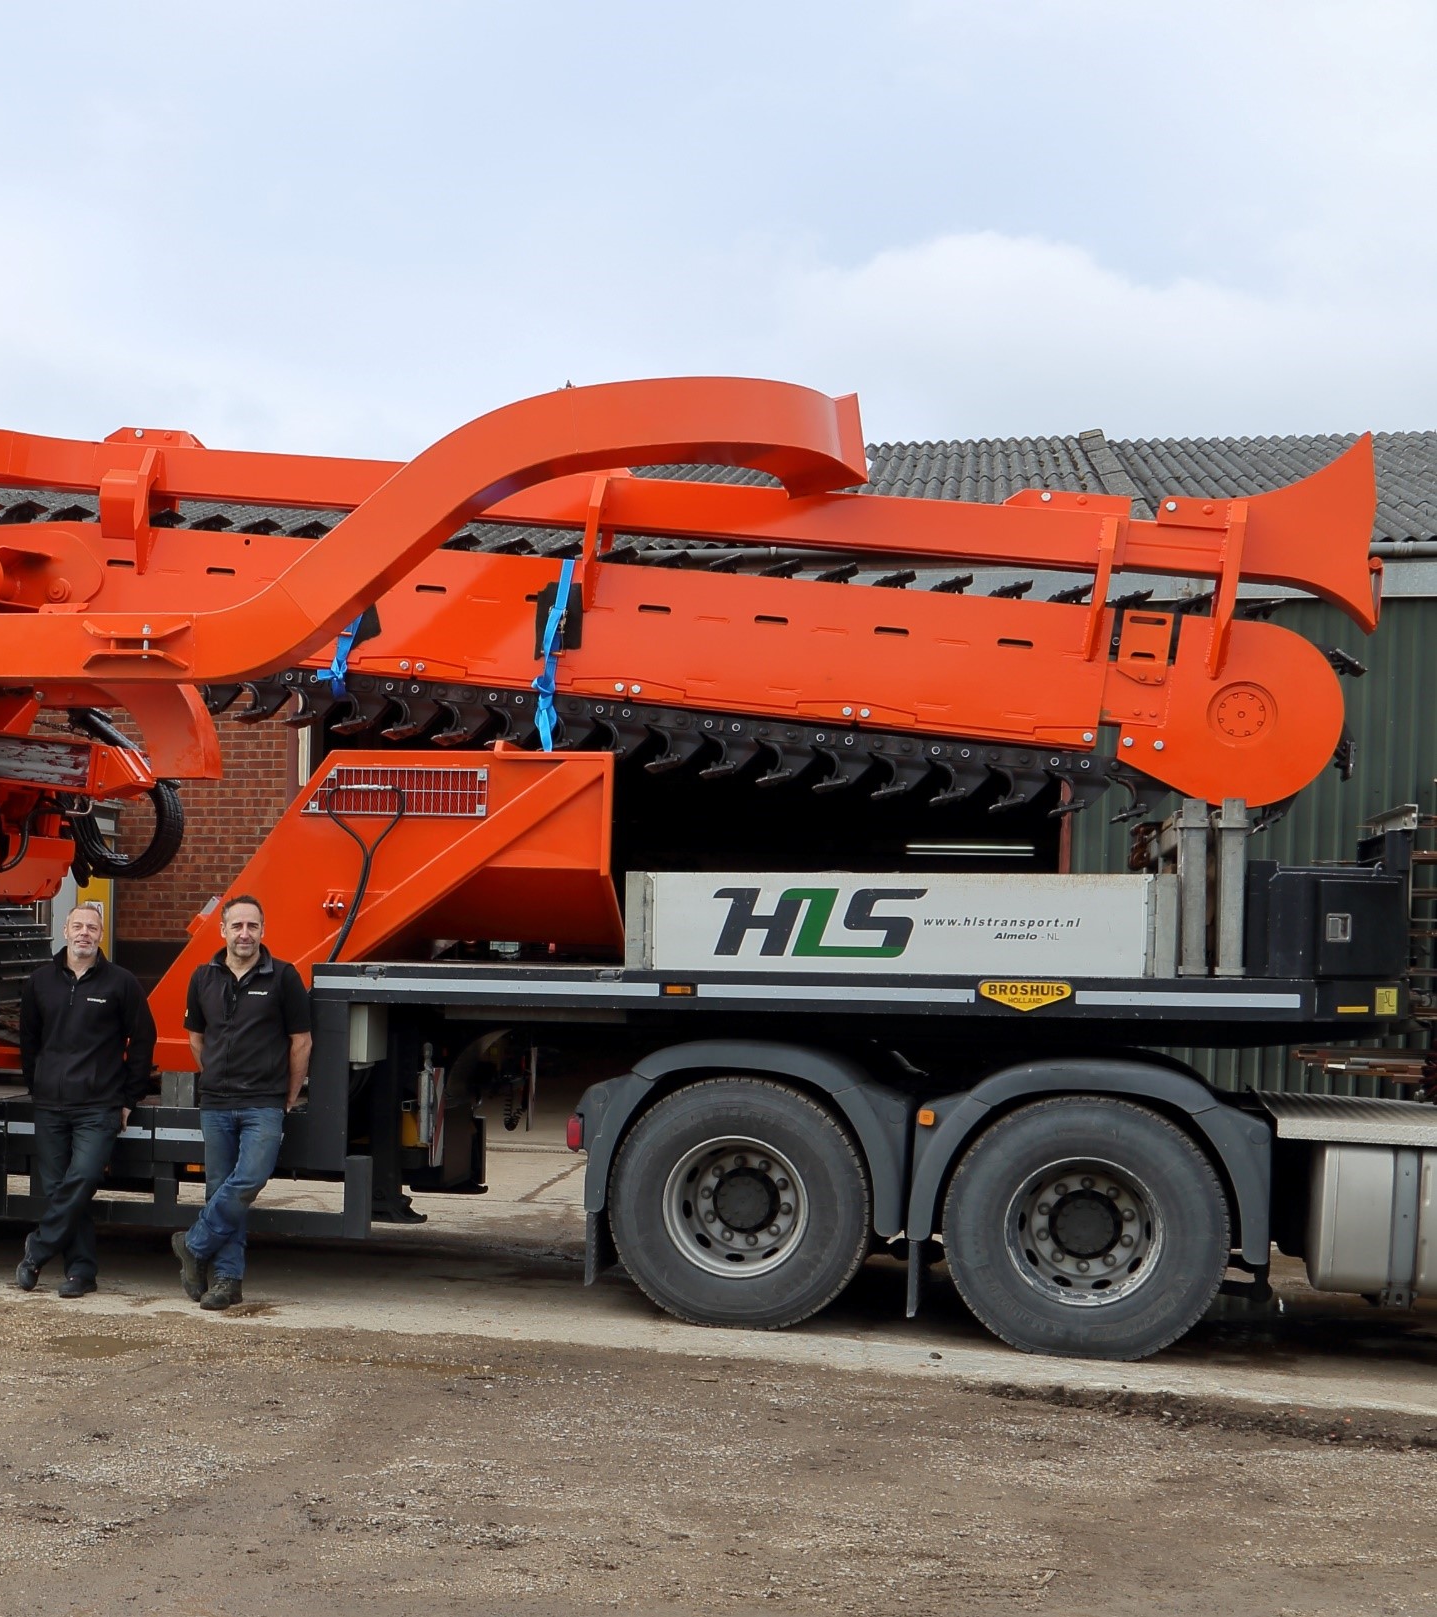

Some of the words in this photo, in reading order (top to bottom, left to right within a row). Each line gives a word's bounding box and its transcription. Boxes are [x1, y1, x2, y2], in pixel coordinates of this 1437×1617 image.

[713, 887, 929, 958] HLS
[923, 917, 1081, 929] www.hlstransport.nl
[994, 932, 1038, 940] Almelo
[1046, 933, 1060, 941] NL
[988, 984, 1065, 996] BROSHUIS
